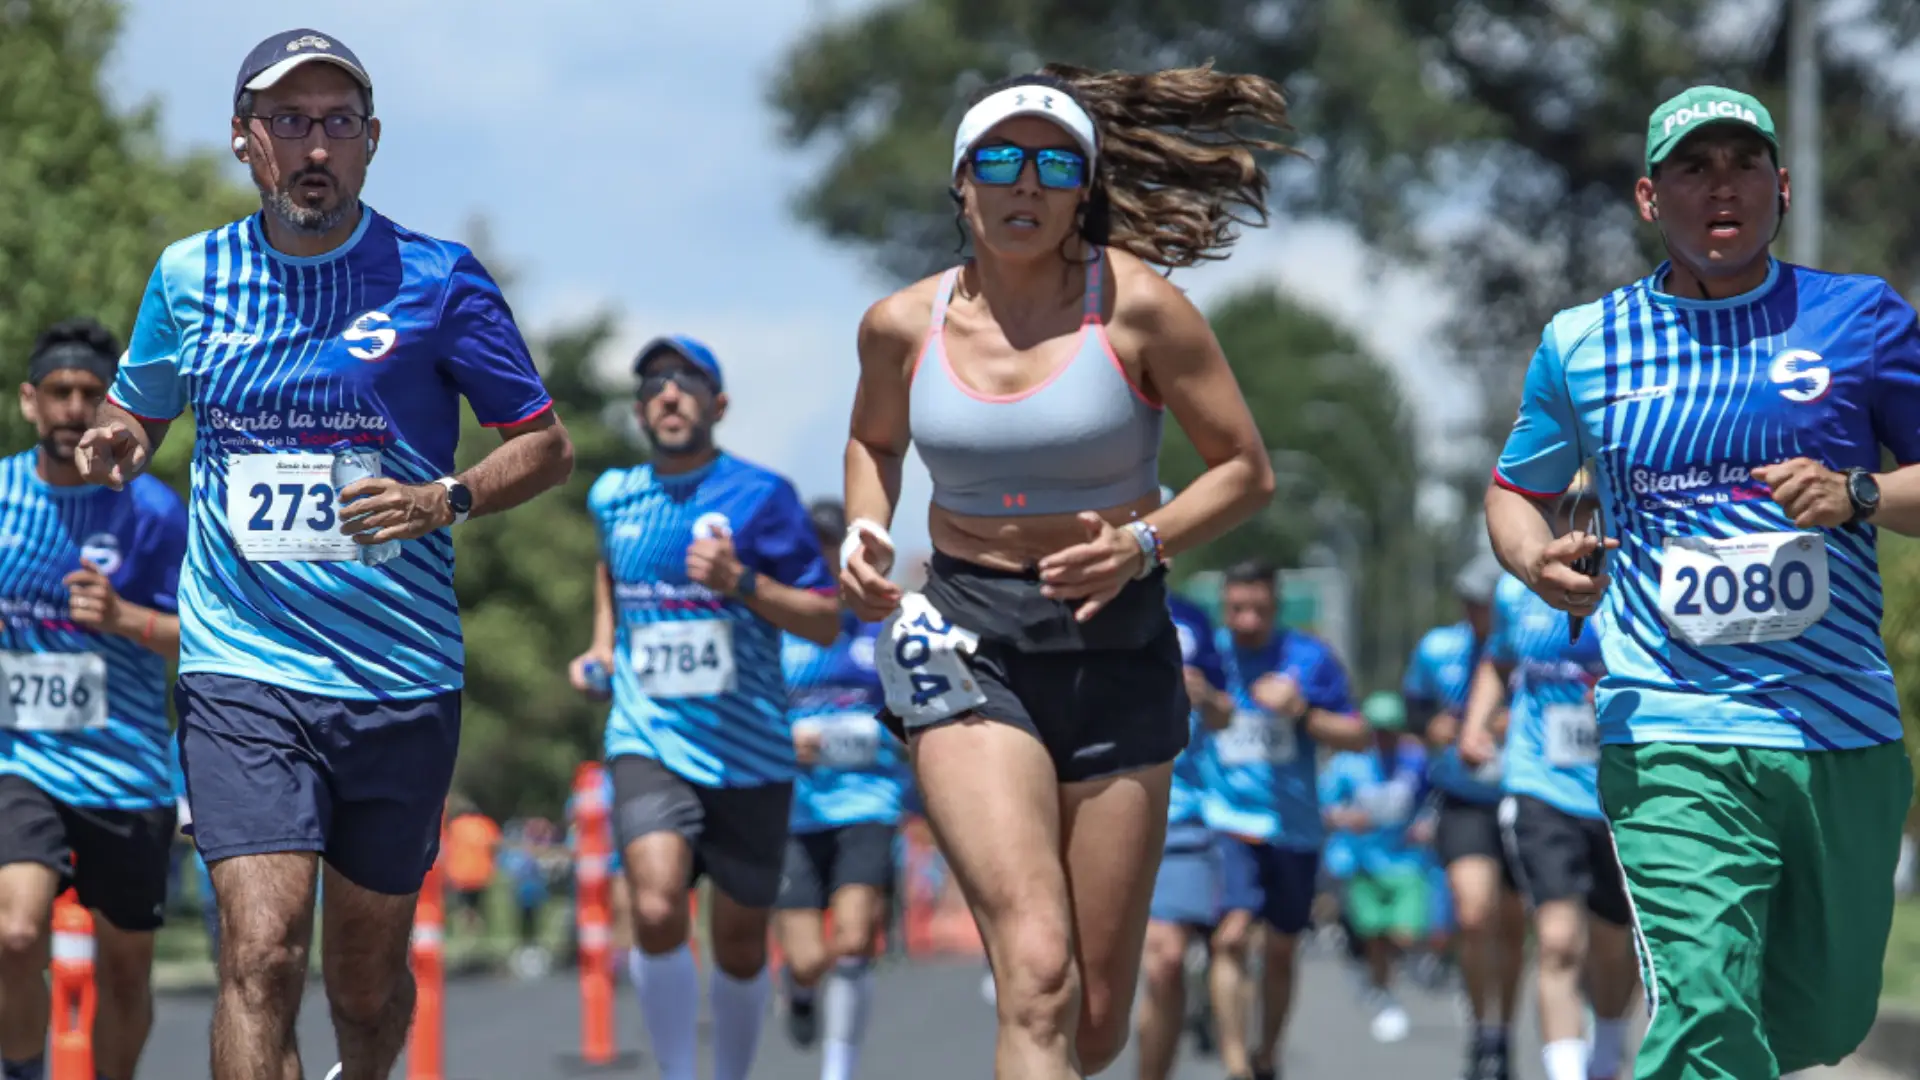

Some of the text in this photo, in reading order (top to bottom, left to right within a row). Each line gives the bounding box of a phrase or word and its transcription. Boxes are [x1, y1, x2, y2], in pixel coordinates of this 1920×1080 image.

[1664, 100, 1758, 138] POLICIA
[210, 408, 388, 431] Siente la vibra
[1633, 467, 1713, 494] Siente
[1718, 462, 1750, 484] la
[1674, 560, 1814, 616] 2080
[640, 639, 719, 676] 2784
[9, 674, 90, 708] 2786
